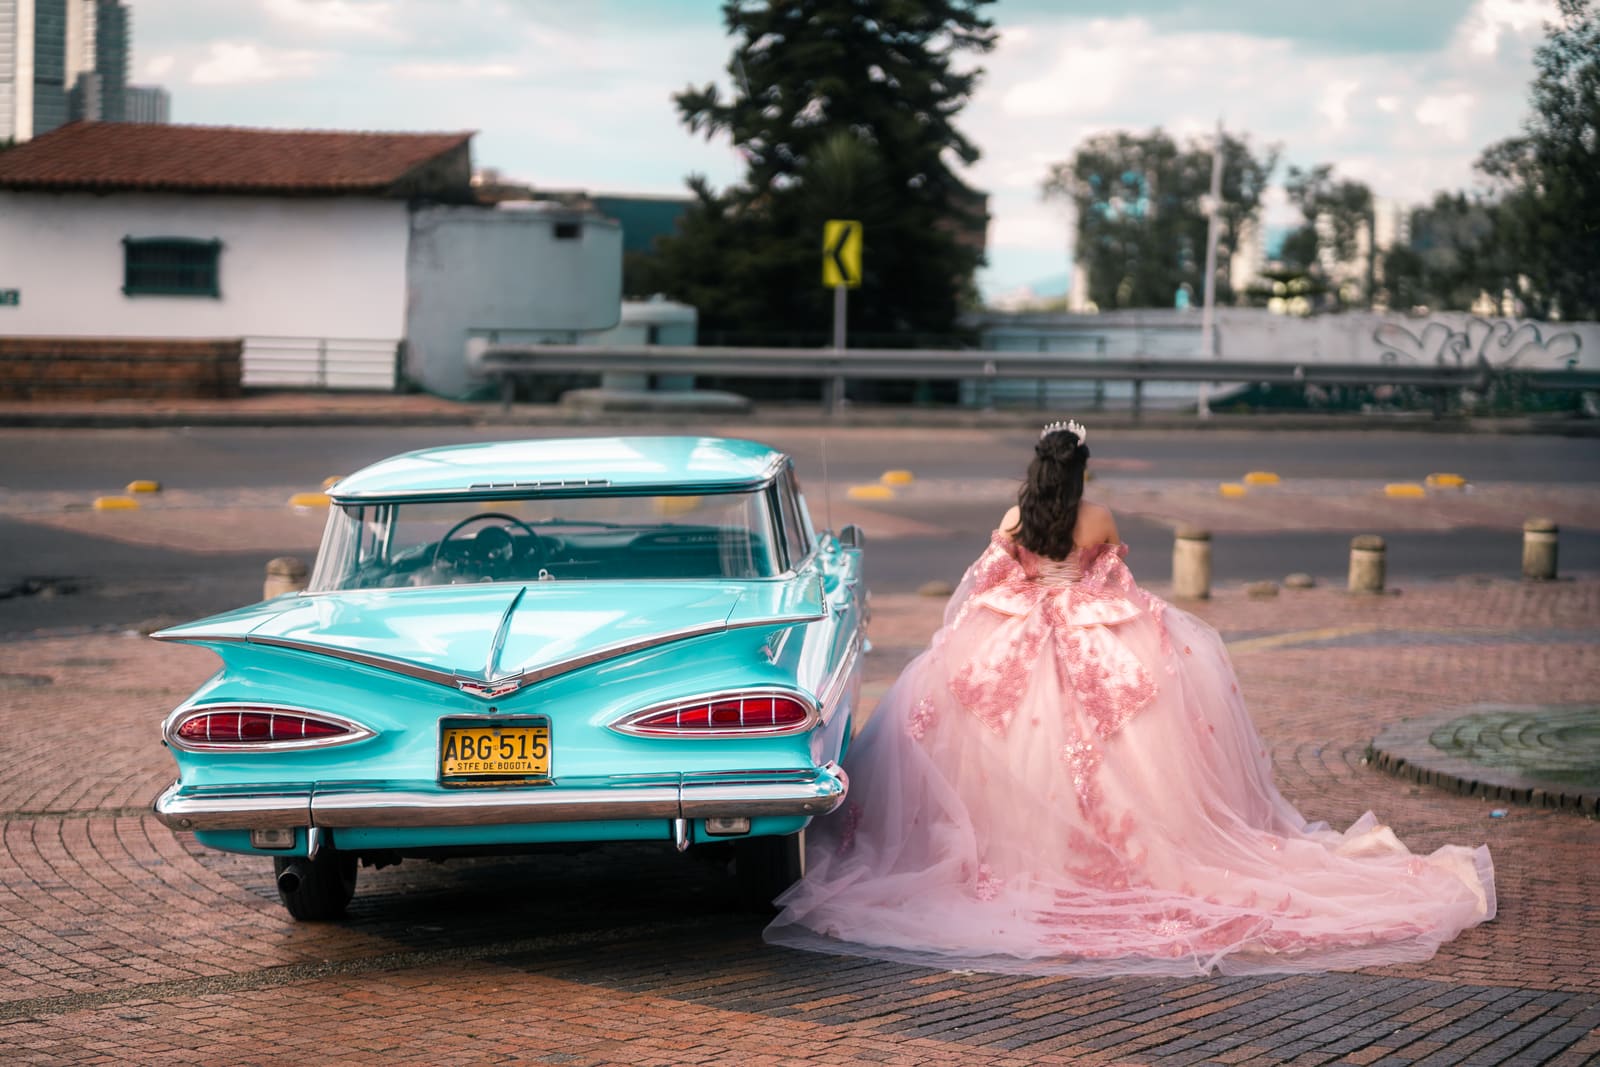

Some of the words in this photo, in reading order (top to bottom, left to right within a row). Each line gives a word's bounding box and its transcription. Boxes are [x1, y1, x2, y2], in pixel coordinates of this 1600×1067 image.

[444, 735, 492, 761] ABG
[499, 734, 548, 760] 515
[457, 762, 480, 770] STFE
[497, 761, 532, 770] BOGOTA
